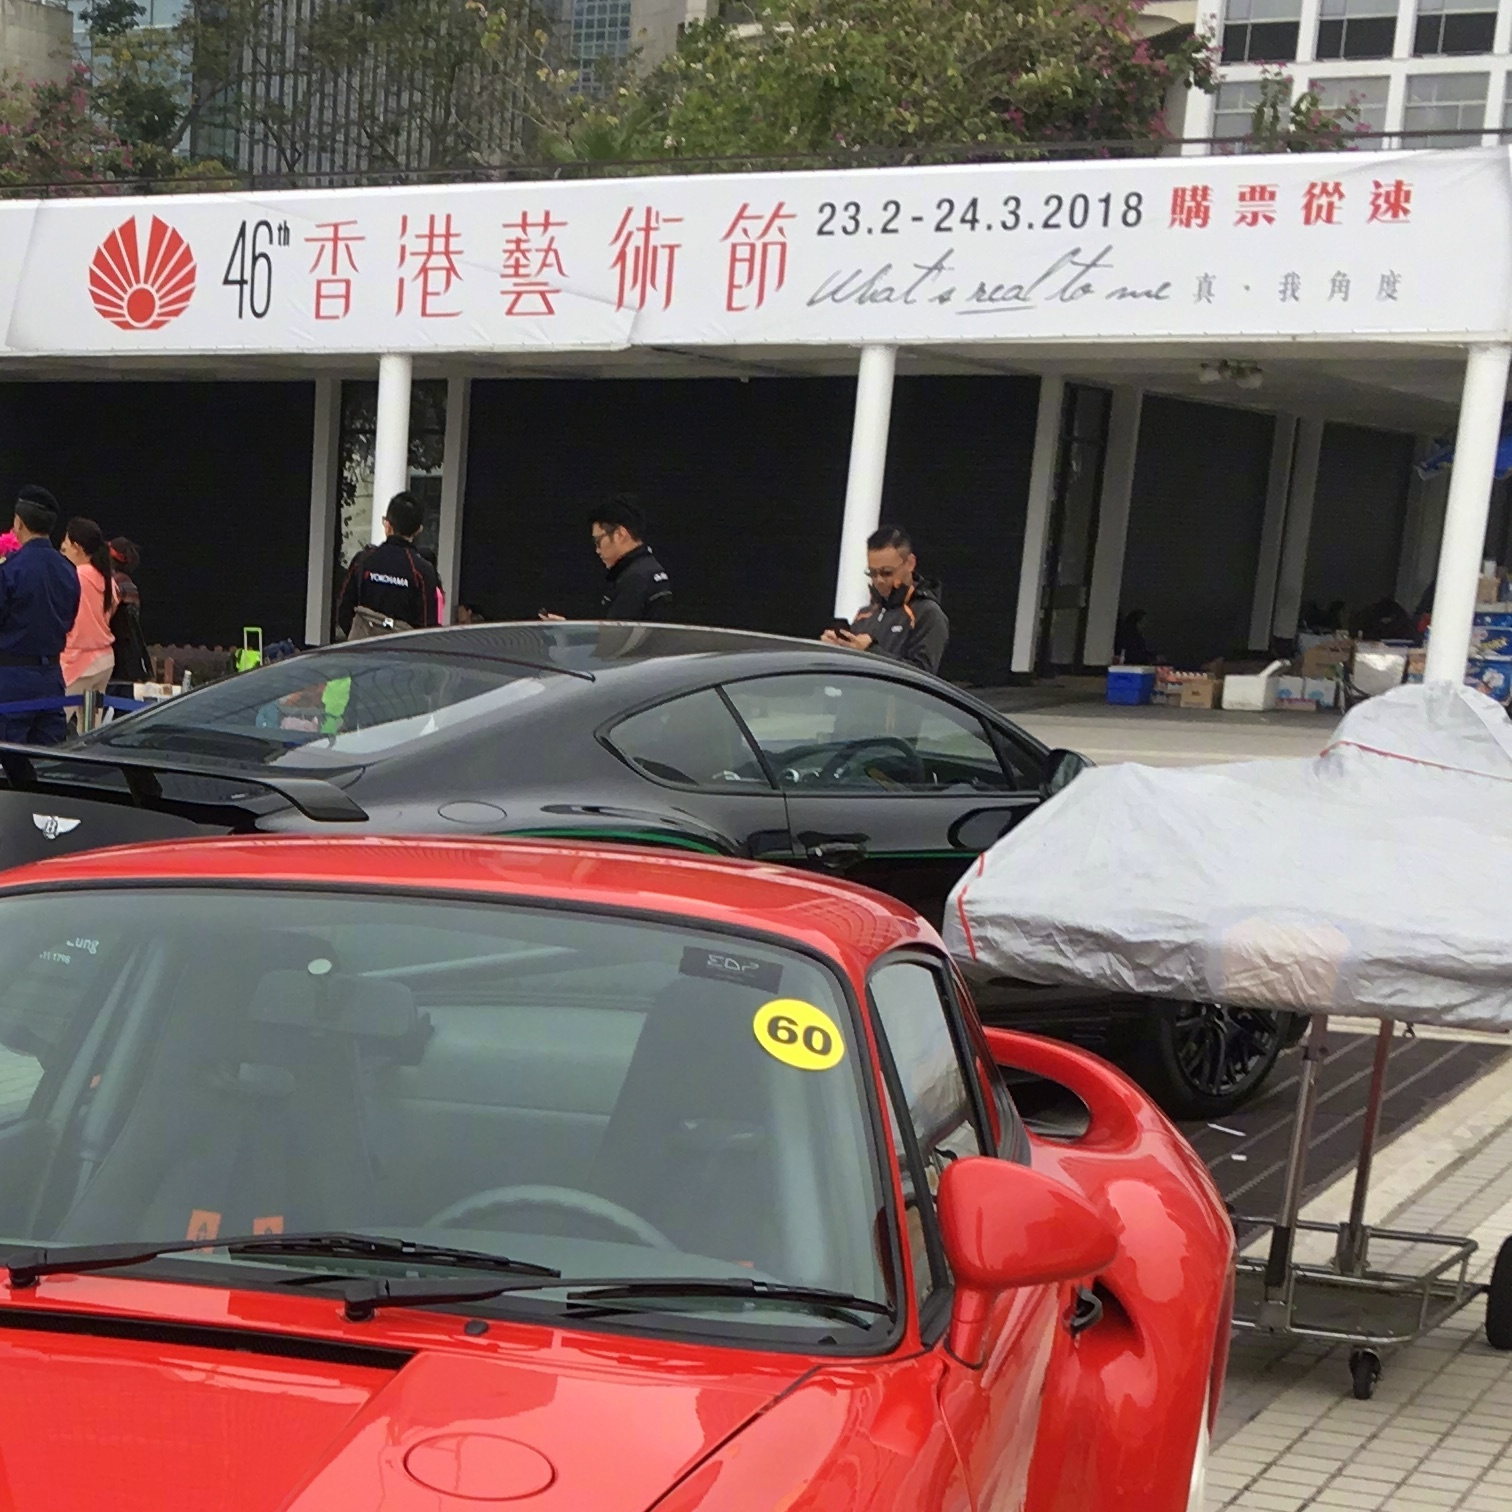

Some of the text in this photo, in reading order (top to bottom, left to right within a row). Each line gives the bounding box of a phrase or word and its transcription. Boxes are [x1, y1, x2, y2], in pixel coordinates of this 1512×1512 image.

[1168, 178, 1413, 230] 購票從速
[222, 201, 797, 320] 46th 香港藝術節
[767, 1015, 833, 1057] 60
